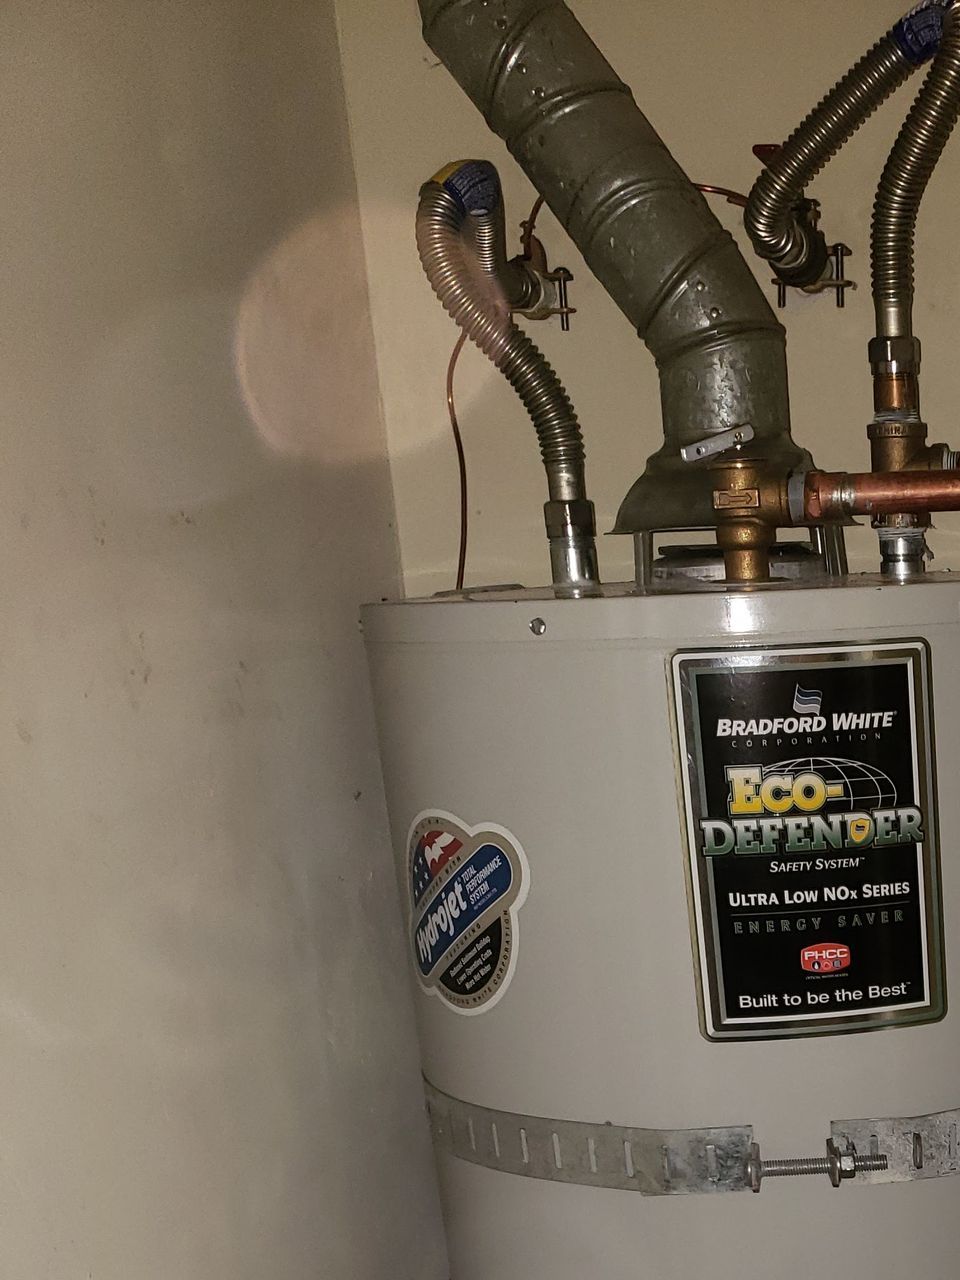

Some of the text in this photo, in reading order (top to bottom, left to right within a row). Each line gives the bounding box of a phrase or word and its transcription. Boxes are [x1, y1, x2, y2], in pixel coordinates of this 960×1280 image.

[716, 716, 827, 737] BRADFORD
[731, 732, 881, 748] CORPORATION
[701, 805, 924, 856] DEFENDER
[461, 865, 477, 883] TOTAL
[465, 855, 502, 894] PERFORMANCE
[769, 861, 812, 873] SAFETY
[470, 880, 490, 905] SYSTEM
[728, 892, 779, 907] ULTRA
[784, 890, 818, 904] LOW
[862, 882, 910, 898] SERIES
[734, 910, 903, 934] ENERGY SAVER
[804, 948, 848, 960] PHCC
[739, 994, 778, 1008] Built
[783, 993, 801, 1006] to
[807, 992, 830, 1005] be
[834, 989, 863, 1002] the
